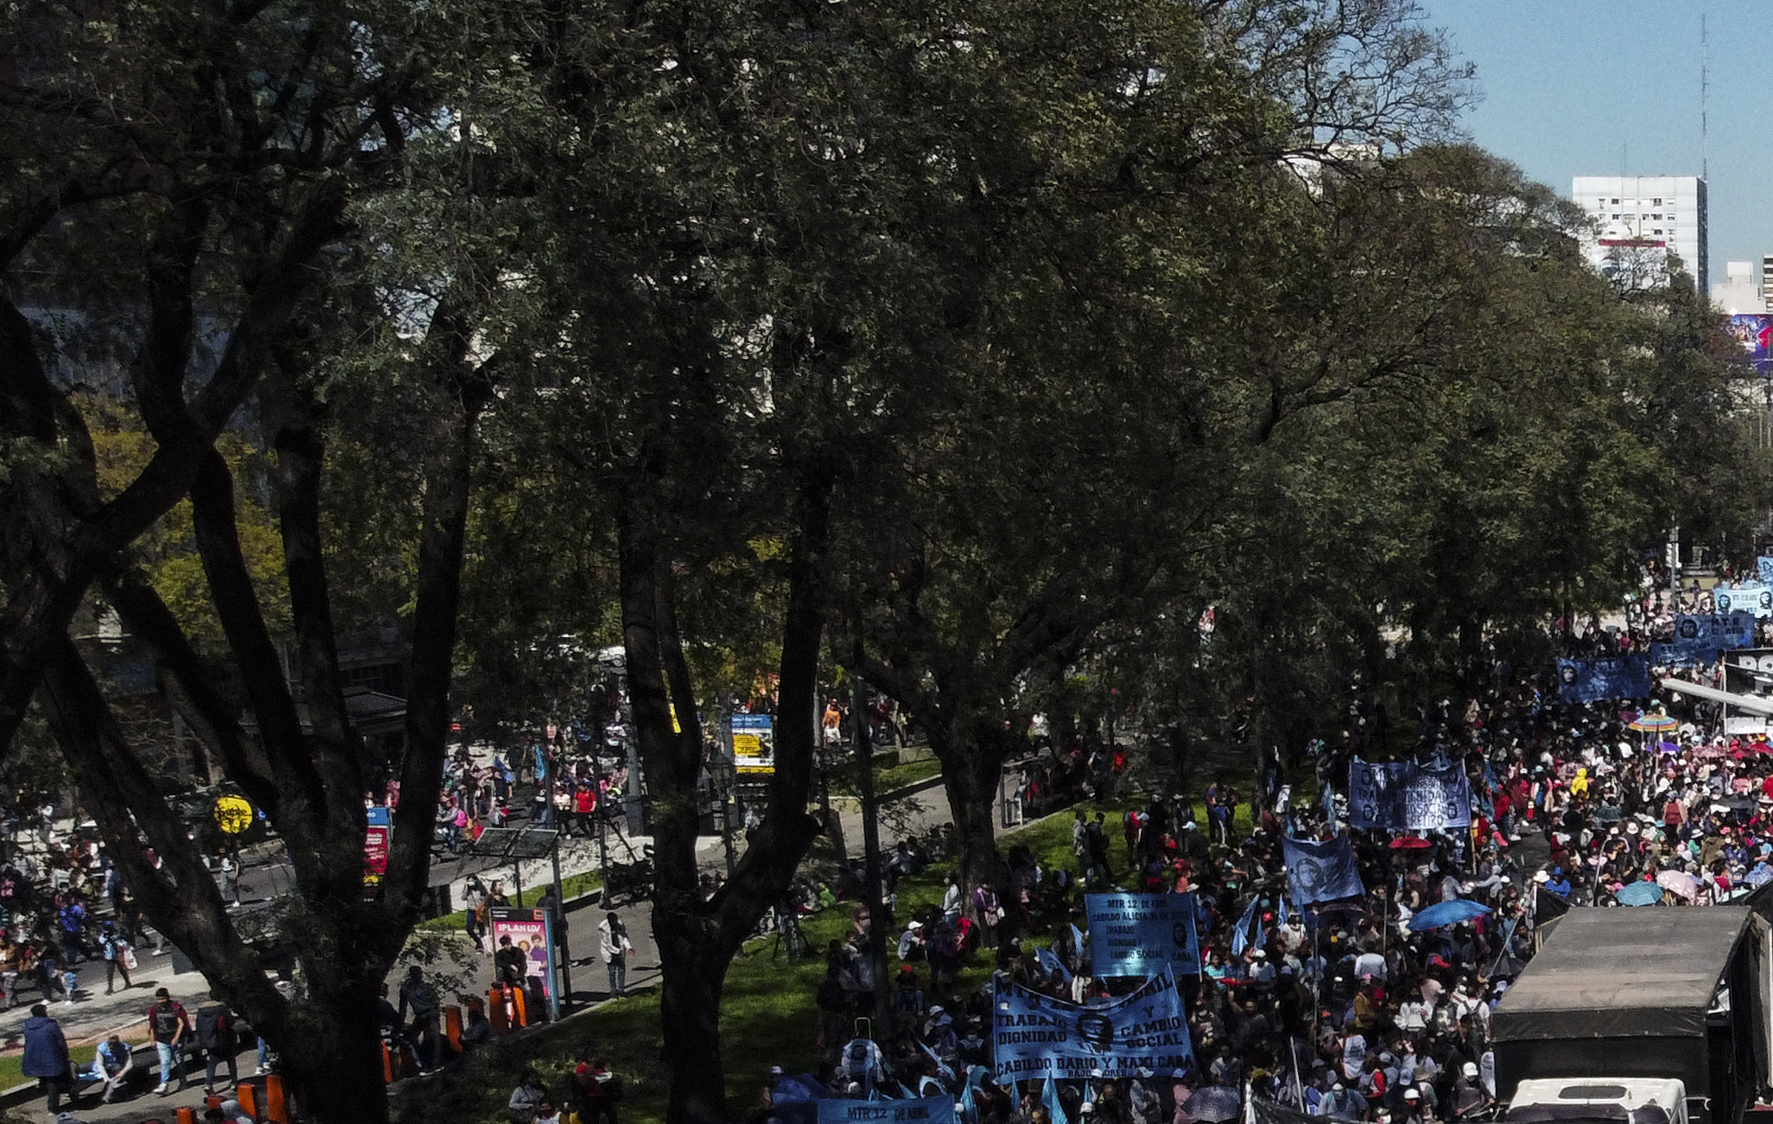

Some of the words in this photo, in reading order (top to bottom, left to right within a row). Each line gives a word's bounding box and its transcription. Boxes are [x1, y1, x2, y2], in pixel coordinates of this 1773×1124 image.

[1143, 1005, 1154, 1018] Y
[997, 1014, 1067, 1028] TRABAJO
[1121, 1017, 1181, 1037] CAMBIO
[998, 1031, 1067, 1045] DIGNIDAD
[1126, 1034, 1183, 1048] SOCIAL
[997, 1057, 1051, 1076] CABILDO
[1056, 1057, 1097, 1070] DARIO
[1101, 1057, 1112, 1069] Y
[1117, 1056, 1154, 1069] MAXI
[847, 1107, 871, 1119] MTR
[875, 1107, 888, 1118] 12
